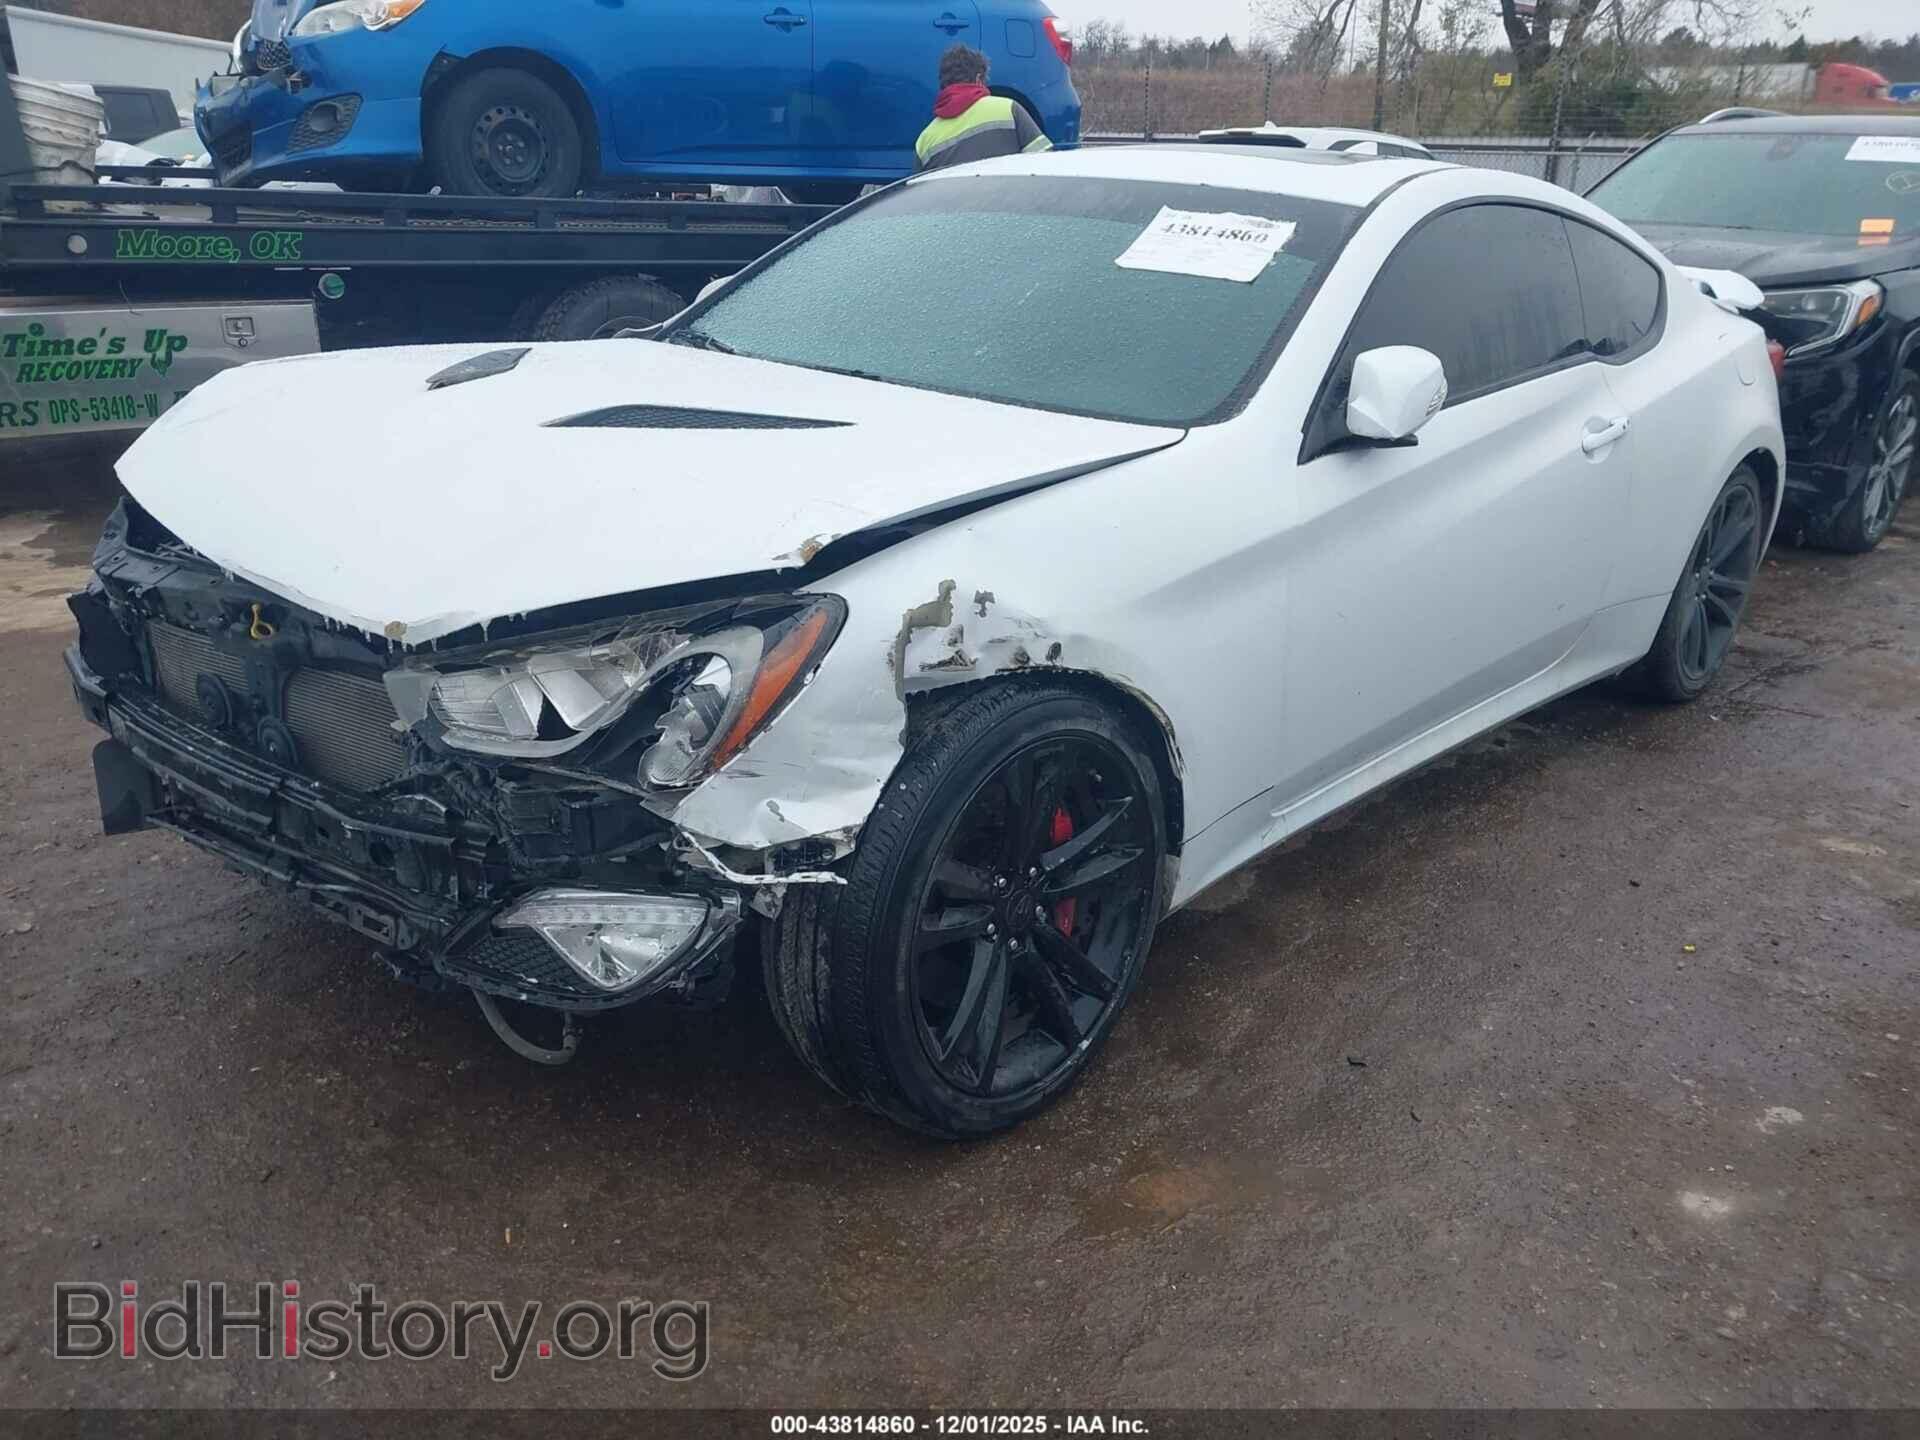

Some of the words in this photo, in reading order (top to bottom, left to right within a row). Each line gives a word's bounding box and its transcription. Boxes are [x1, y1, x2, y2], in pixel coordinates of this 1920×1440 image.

[117, 229, 241, 263] Moore,
[250, 231, 302, 260] OK
[2, 323, 126, 358] Time's
[143, 329, 188, 374] Up
[15, 358, 144, 383] RECOVERY
[49, 393, 160, 425] DPS-53418-W
